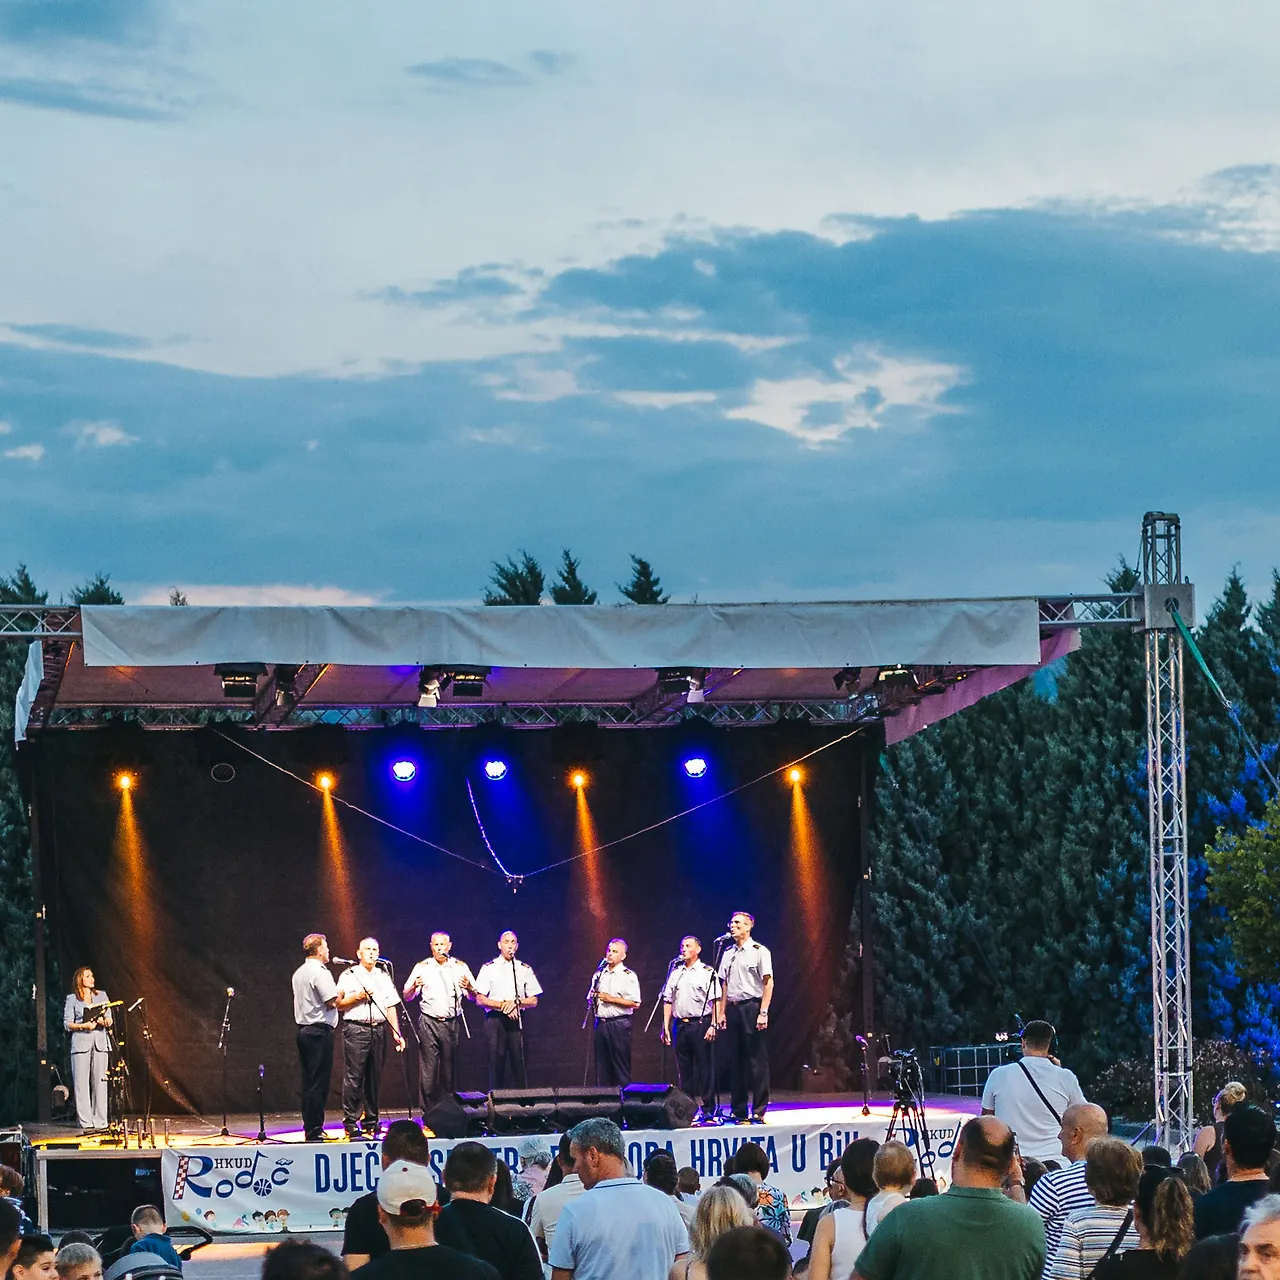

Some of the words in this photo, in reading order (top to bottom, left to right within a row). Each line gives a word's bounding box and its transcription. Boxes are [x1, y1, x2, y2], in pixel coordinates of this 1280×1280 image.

[921, 1128, 955, 1140] KUD
[214, 1157, 252, 1169] HKUD
[315, 1143, 380, 1193] DJEČ
[791, 1134, 806, 1172] U
